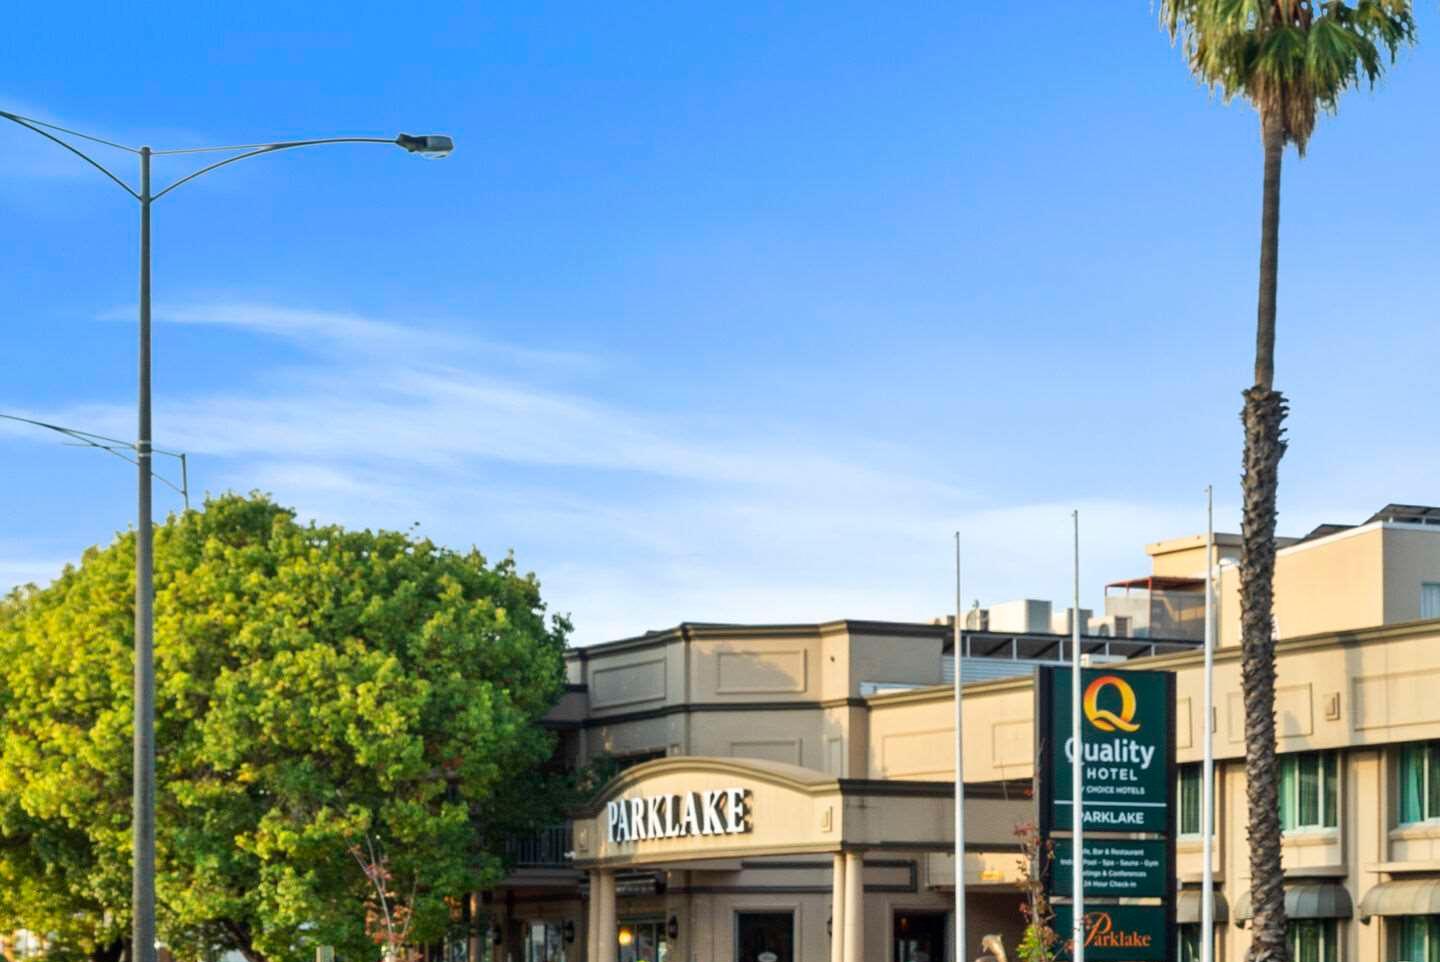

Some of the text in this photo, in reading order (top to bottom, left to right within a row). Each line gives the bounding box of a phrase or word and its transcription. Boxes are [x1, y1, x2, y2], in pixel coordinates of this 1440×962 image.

[1086, 767, 1138, 781] HOTEL
[1086, 785, 1115, 794] CHOICE
[1116, 786, 1146, 795] HOTELS
[606, 787, 746, 843] PARKLAKE
[1081, 811, 1145, 824] ARKLAKE
[1083, 912, 1152, 948] Parklake
